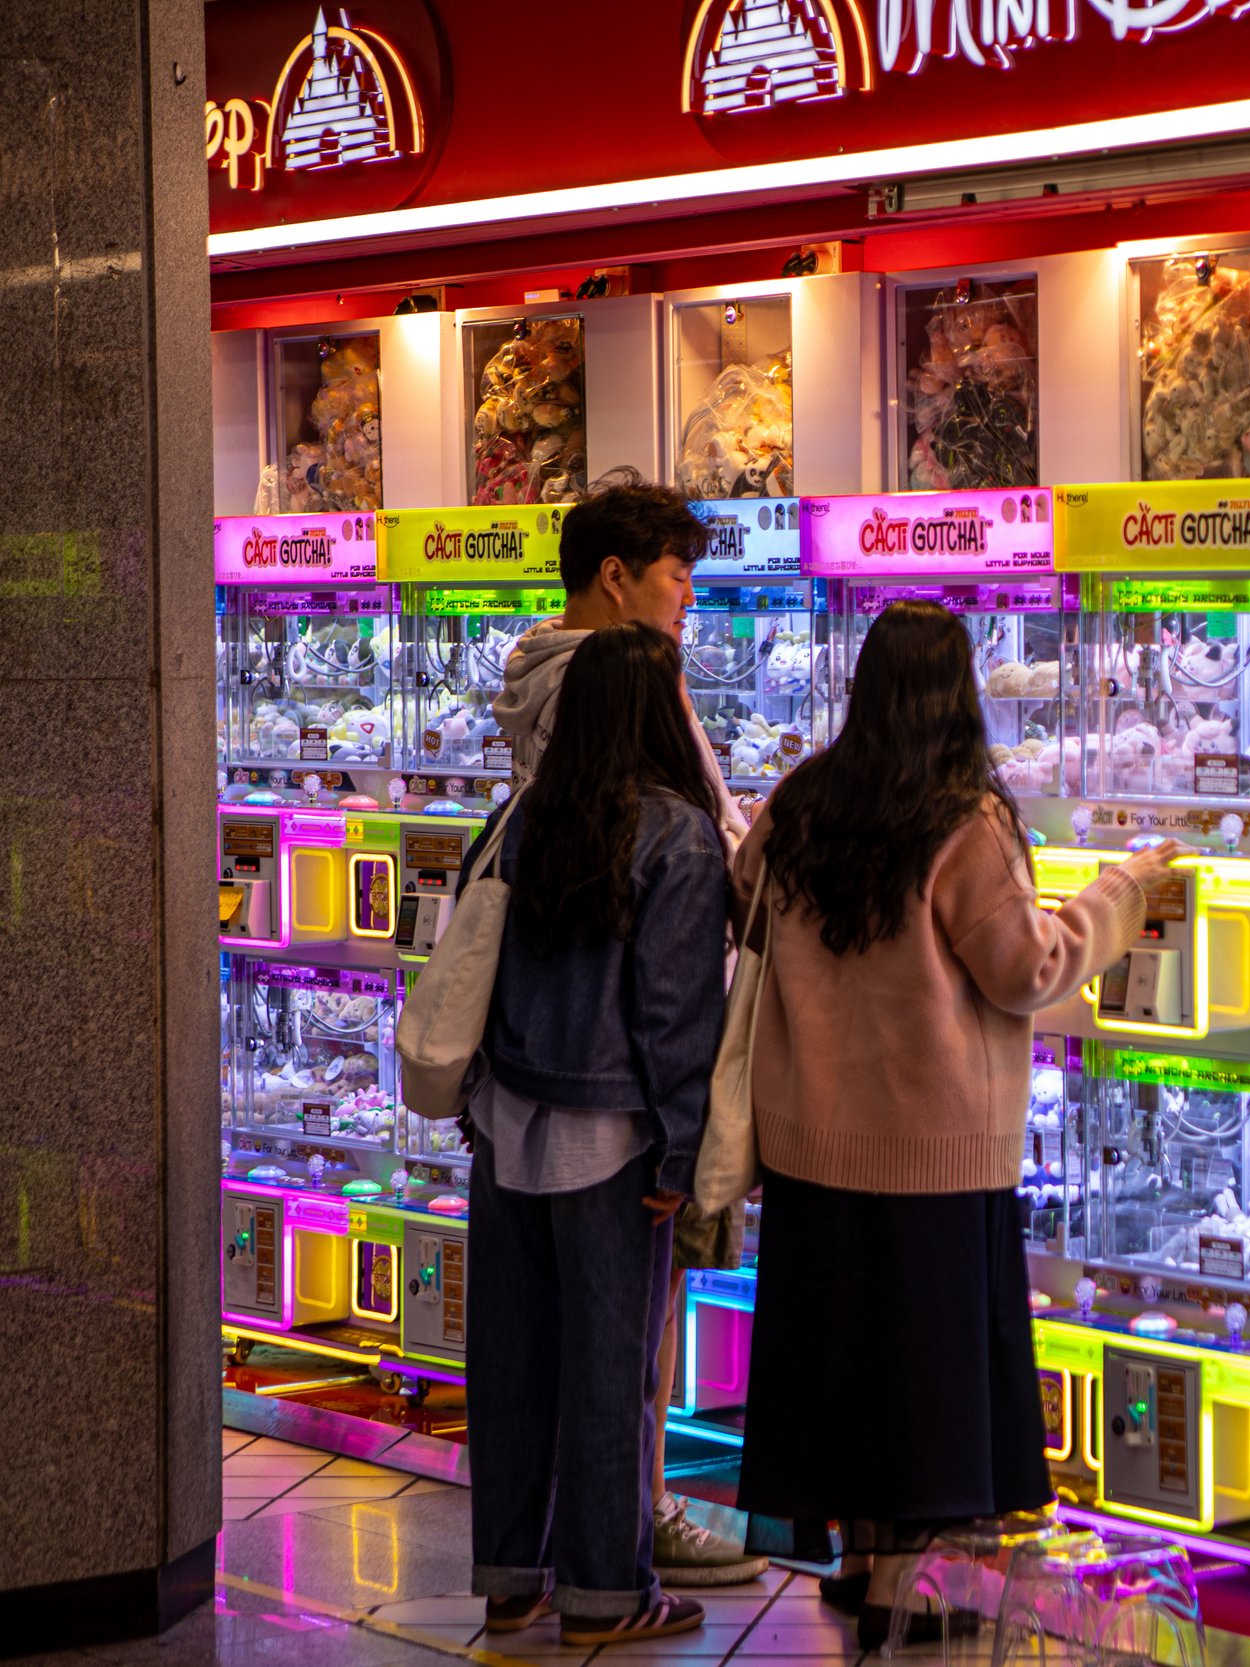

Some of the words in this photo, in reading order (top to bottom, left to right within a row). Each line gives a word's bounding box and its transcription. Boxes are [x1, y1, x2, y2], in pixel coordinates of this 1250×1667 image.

[1066, 491, 1088, 504] there!
[708, 526, 744, 557] CHA!
[912, 519, 986, 552] GOTCHA!
[280, 536, 331, 565] GOTCHA!
[465, 531, 524, 560] GOTCHA!
[985, 560, 1010, 568] LITTLE
[1013, 559, 1051, 567] EUPHORIA
[446, 600, 480, 608] KITSCHY
[482, 600, 522, 608] ARCHIVES
[1193, 592, 1250, 604] ARCHIVES
[268, 601, 299, 611] KITSCHY
[301, 601, 337, 610] ARCHIVES
[426, 734, 440, 748] HOT
[783, 736, 801, 752] NEW
[1130, 812, 1147, 825] For
[1149, 815, 1169, 827] Your
